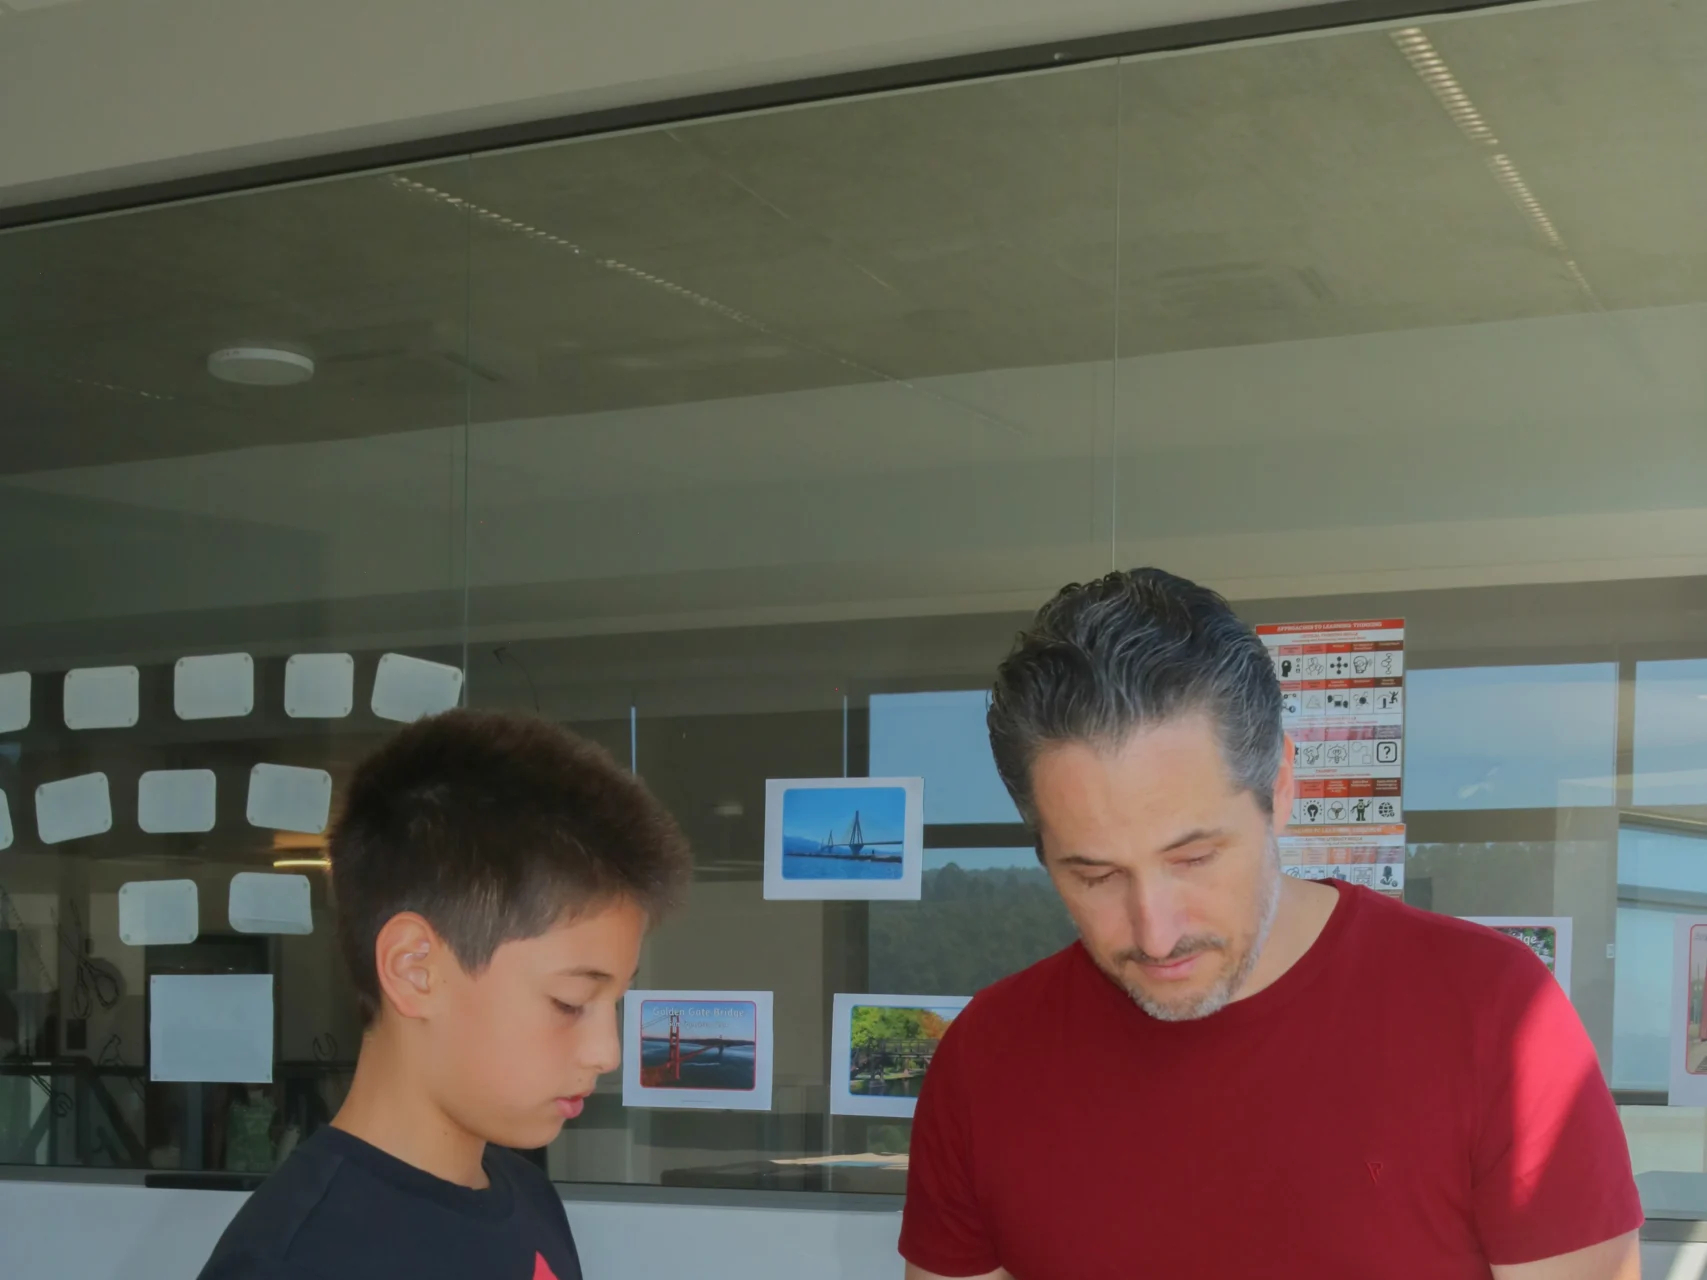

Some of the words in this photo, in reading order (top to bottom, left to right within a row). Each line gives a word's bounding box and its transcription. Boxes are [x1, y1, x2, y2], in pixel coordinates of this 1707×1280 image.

[652, 1006, 685, 1017] Golden
[688, 1007, 710, 1017] Gate
[713, 1007, 745, 1018] Bridge
